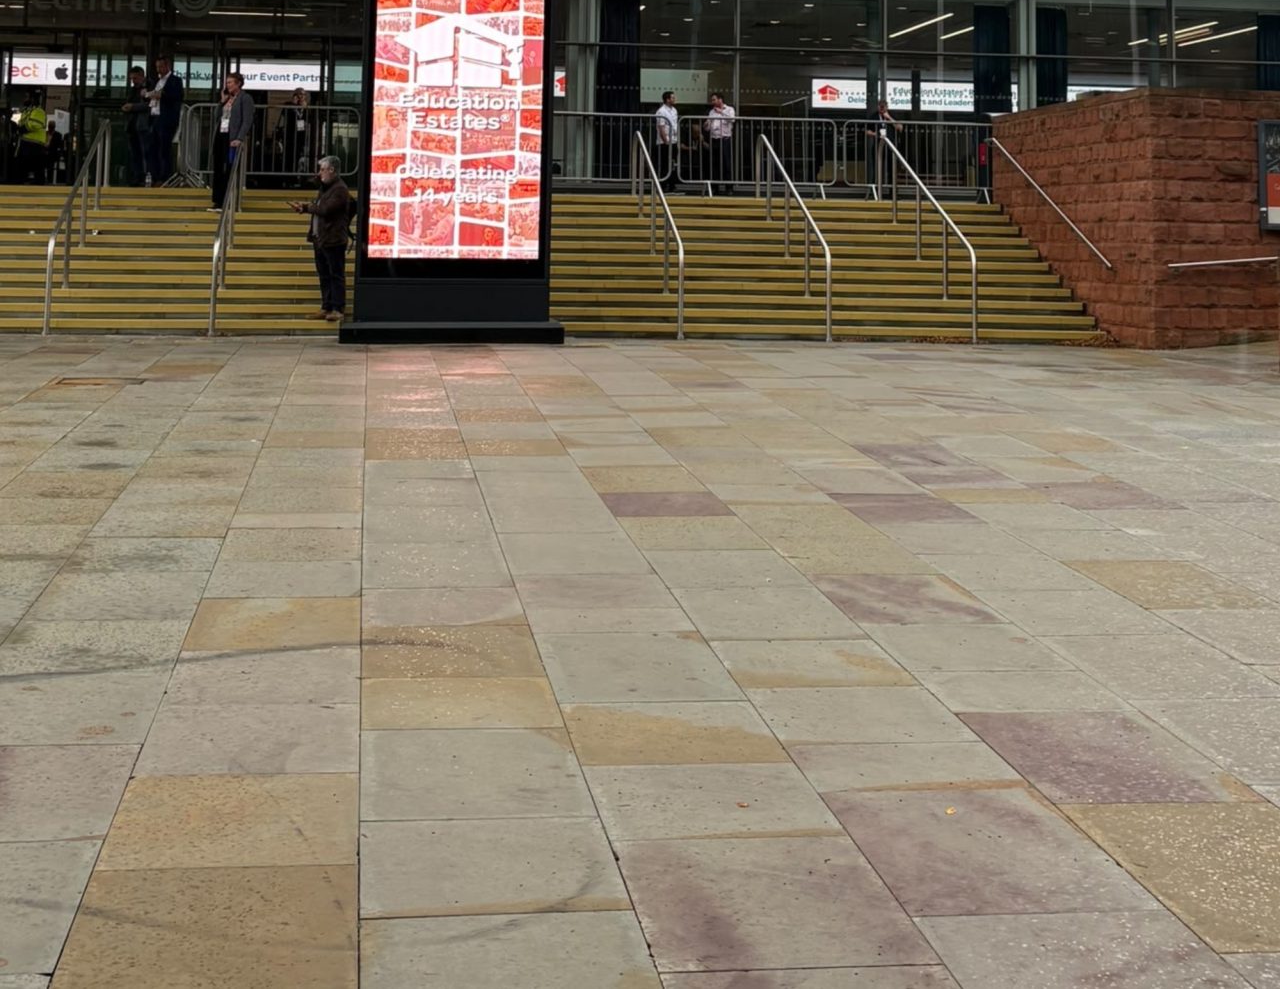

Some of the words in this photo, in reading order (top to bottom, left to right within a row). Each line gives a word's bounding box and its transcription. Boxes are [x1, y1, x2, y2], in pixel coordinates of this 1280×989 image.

[260, 72, 290, 81] Event
[399, 93, 521, 110] Education
[396, 164, 518, 183] Celebrating
[413, 188, 435, 203] 14
[437, 189, 499, 207] years
